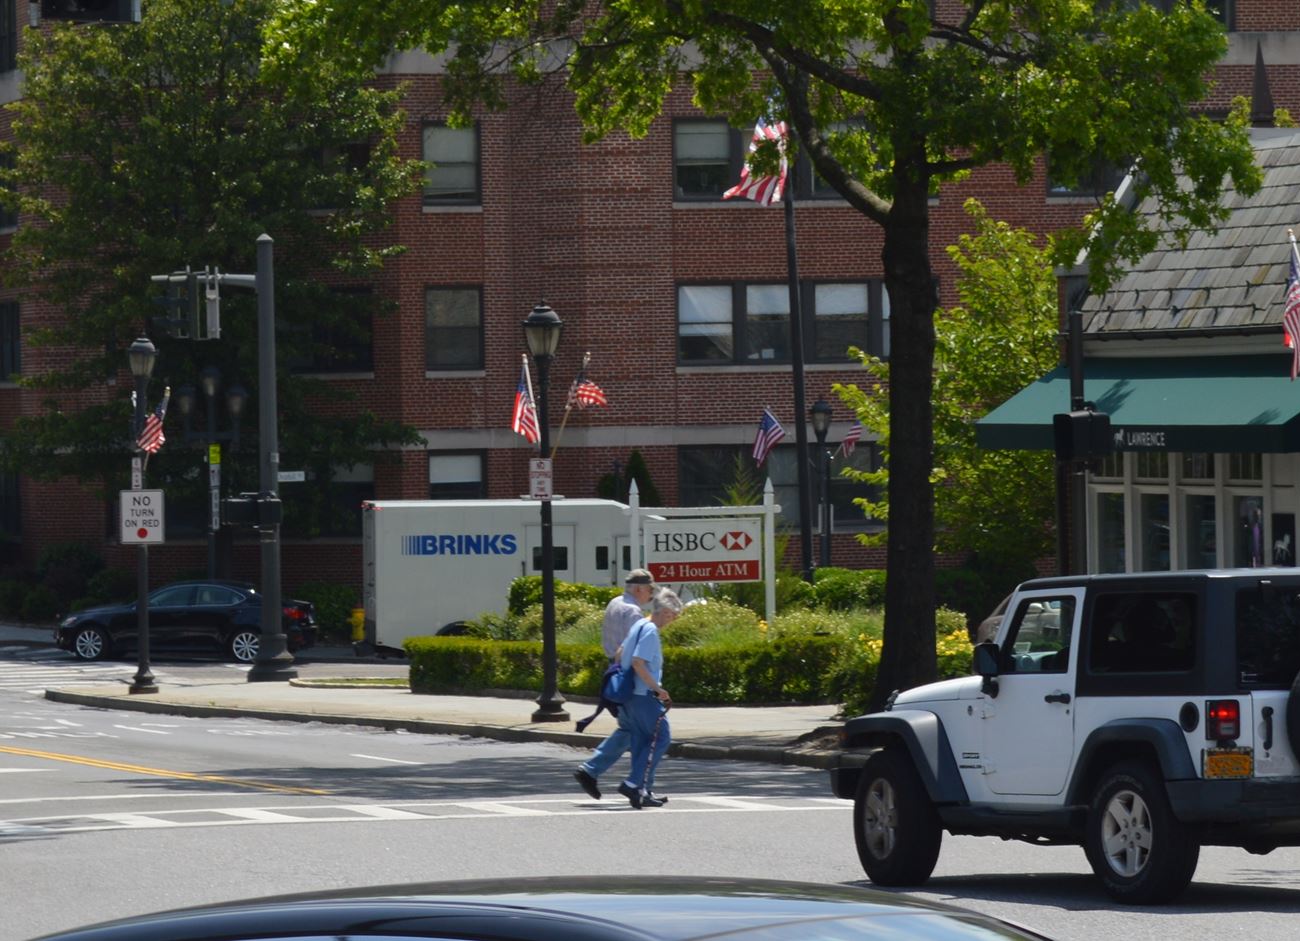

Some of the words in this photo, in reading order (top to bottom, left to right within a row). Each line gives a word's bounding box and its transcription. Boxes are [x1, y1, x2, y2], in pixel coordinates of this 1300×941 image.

[1126, 432, 1166, 446] LAWRENCE
[132, 496, 151, 506] NO
[130, 508, 155, 517] TURN
[124, 519, 138, 528] ON
[142, 519, 160, 528] RED
[421, 533, 518, 556] BRINKS
[652, 531, 716, 552] HSBC
[660, 565, 675, 578] 24
[680, 565, 712, 577] Hour
[715, 563, 748, 576] ATM
